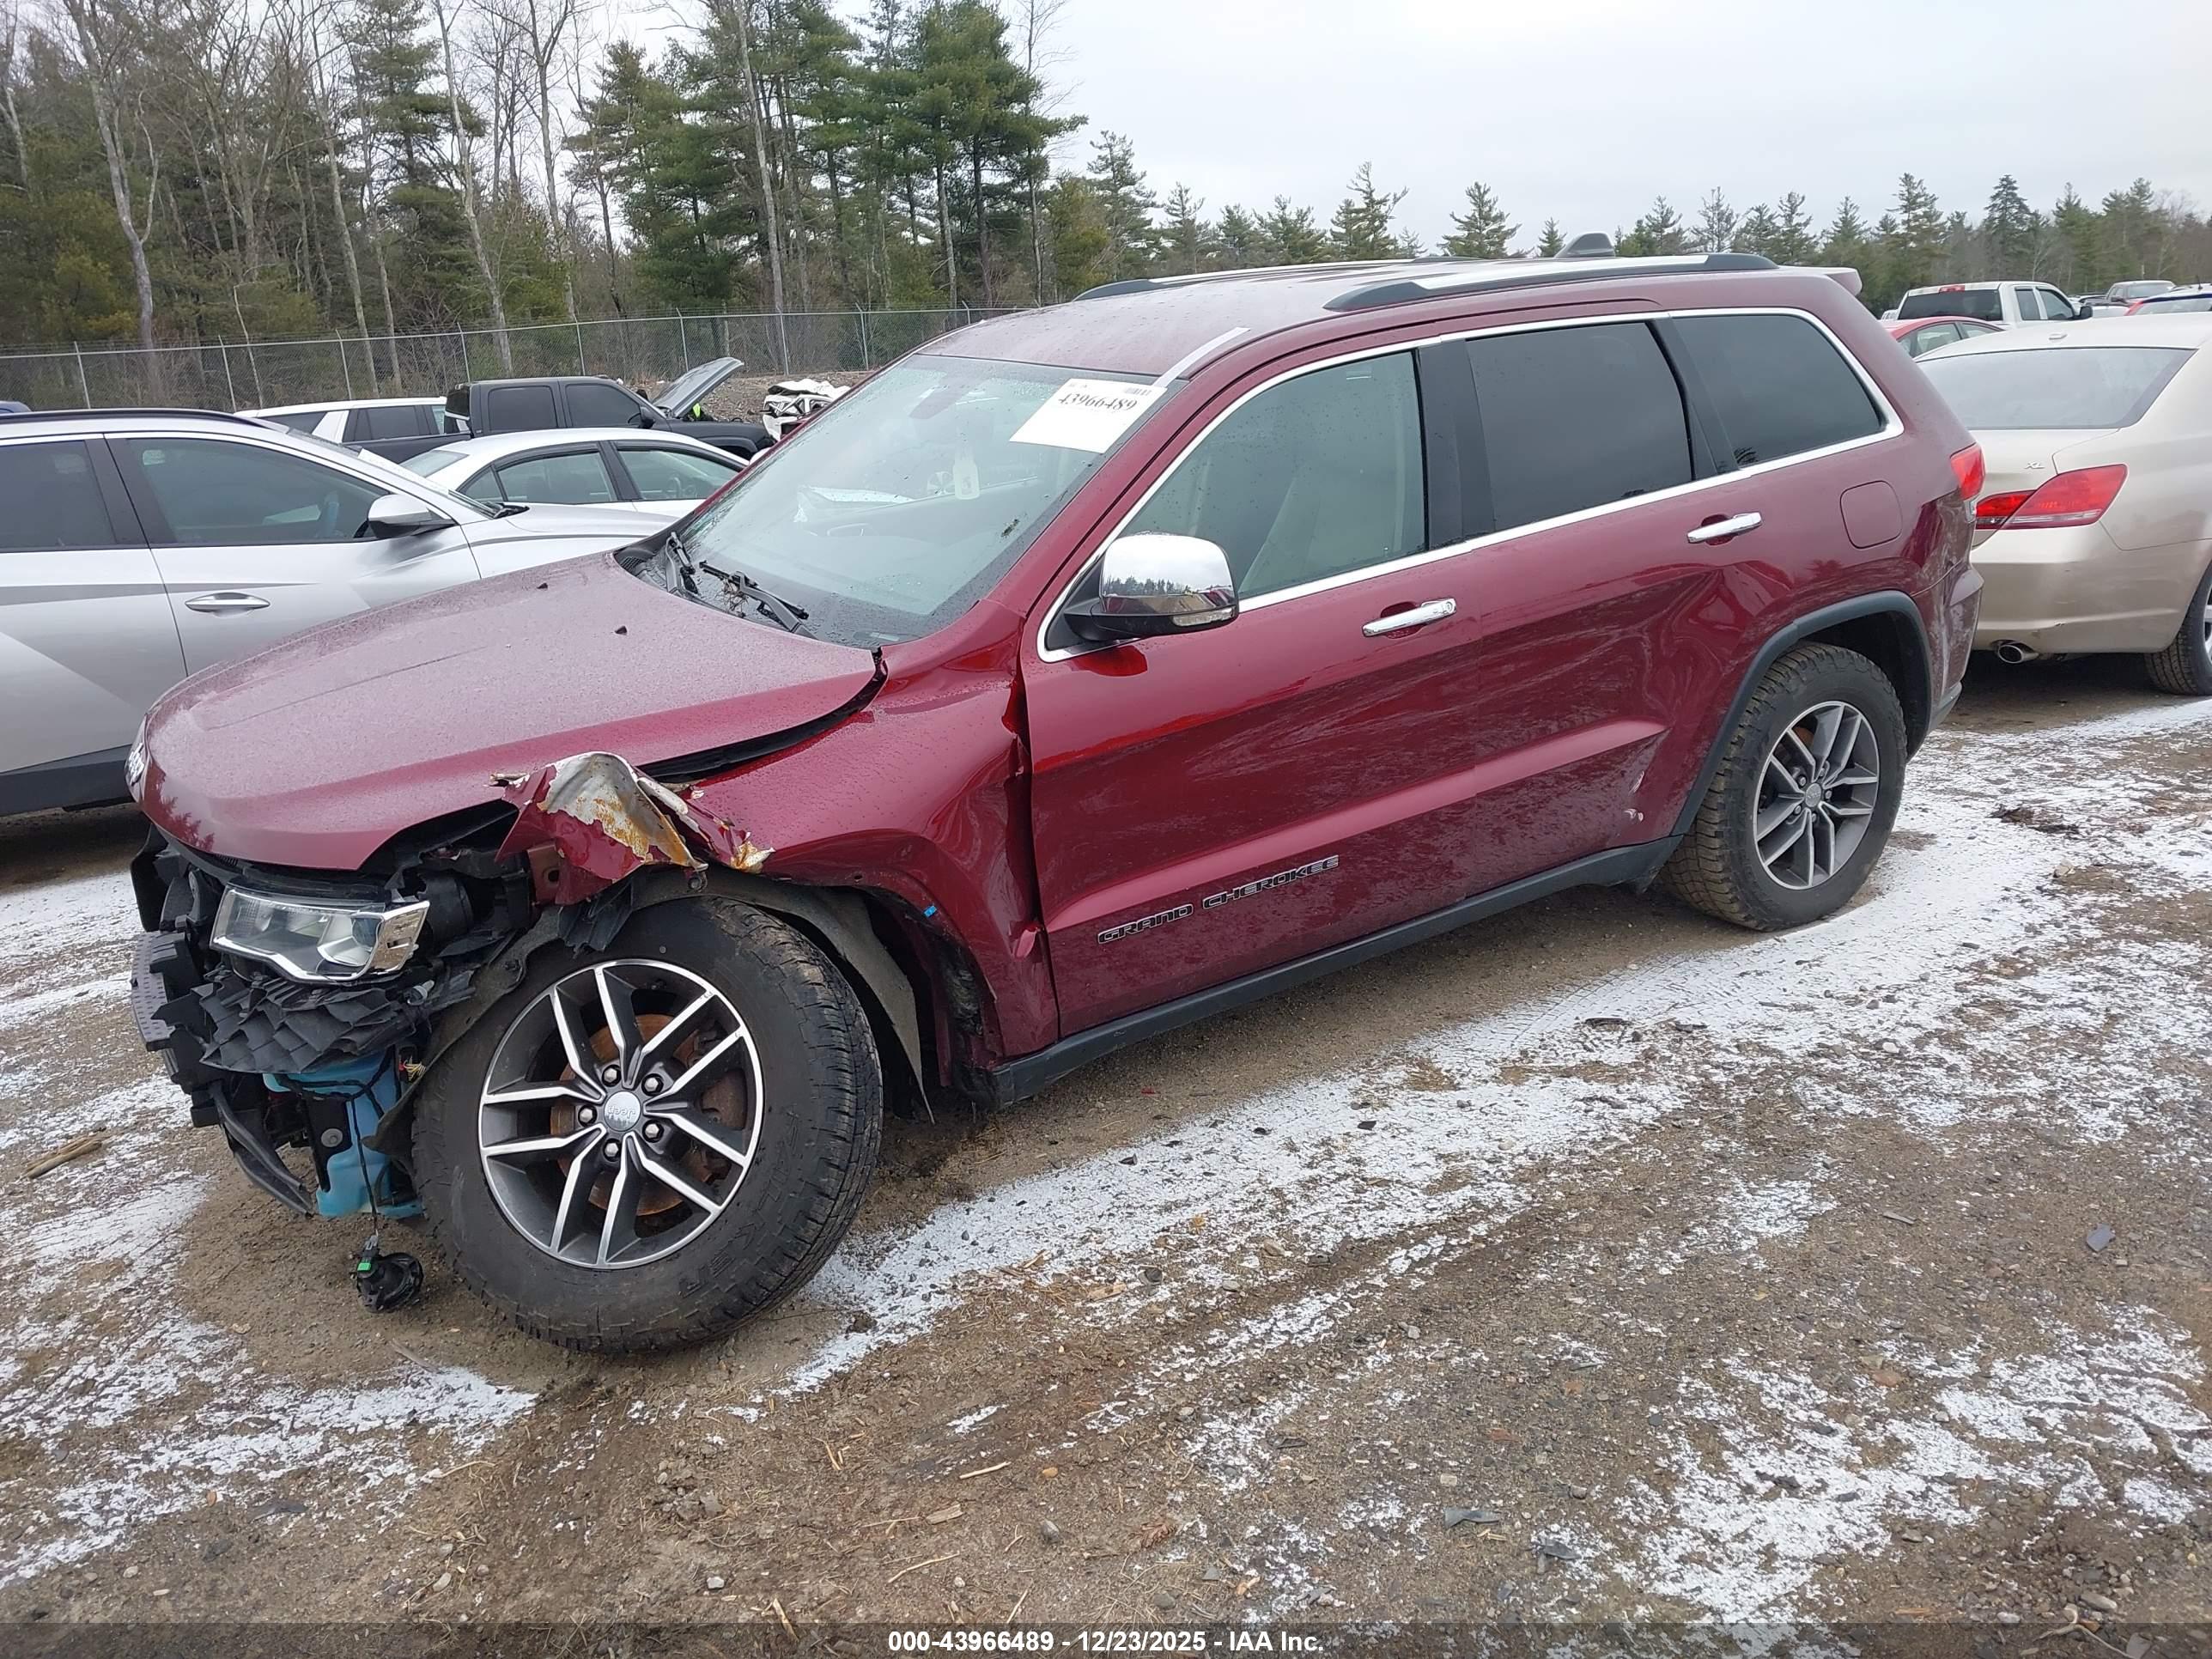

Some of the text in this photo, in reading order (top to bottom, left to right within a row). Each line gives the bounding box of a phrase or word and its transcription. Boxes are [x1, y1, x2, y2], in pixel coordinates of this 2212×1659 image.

[1058, 392, 1138, 411] 43966489
[1097, 854, 1340, 945] GRAND CHEROKEE
[607, 1105, 637, 1119] Jeep
